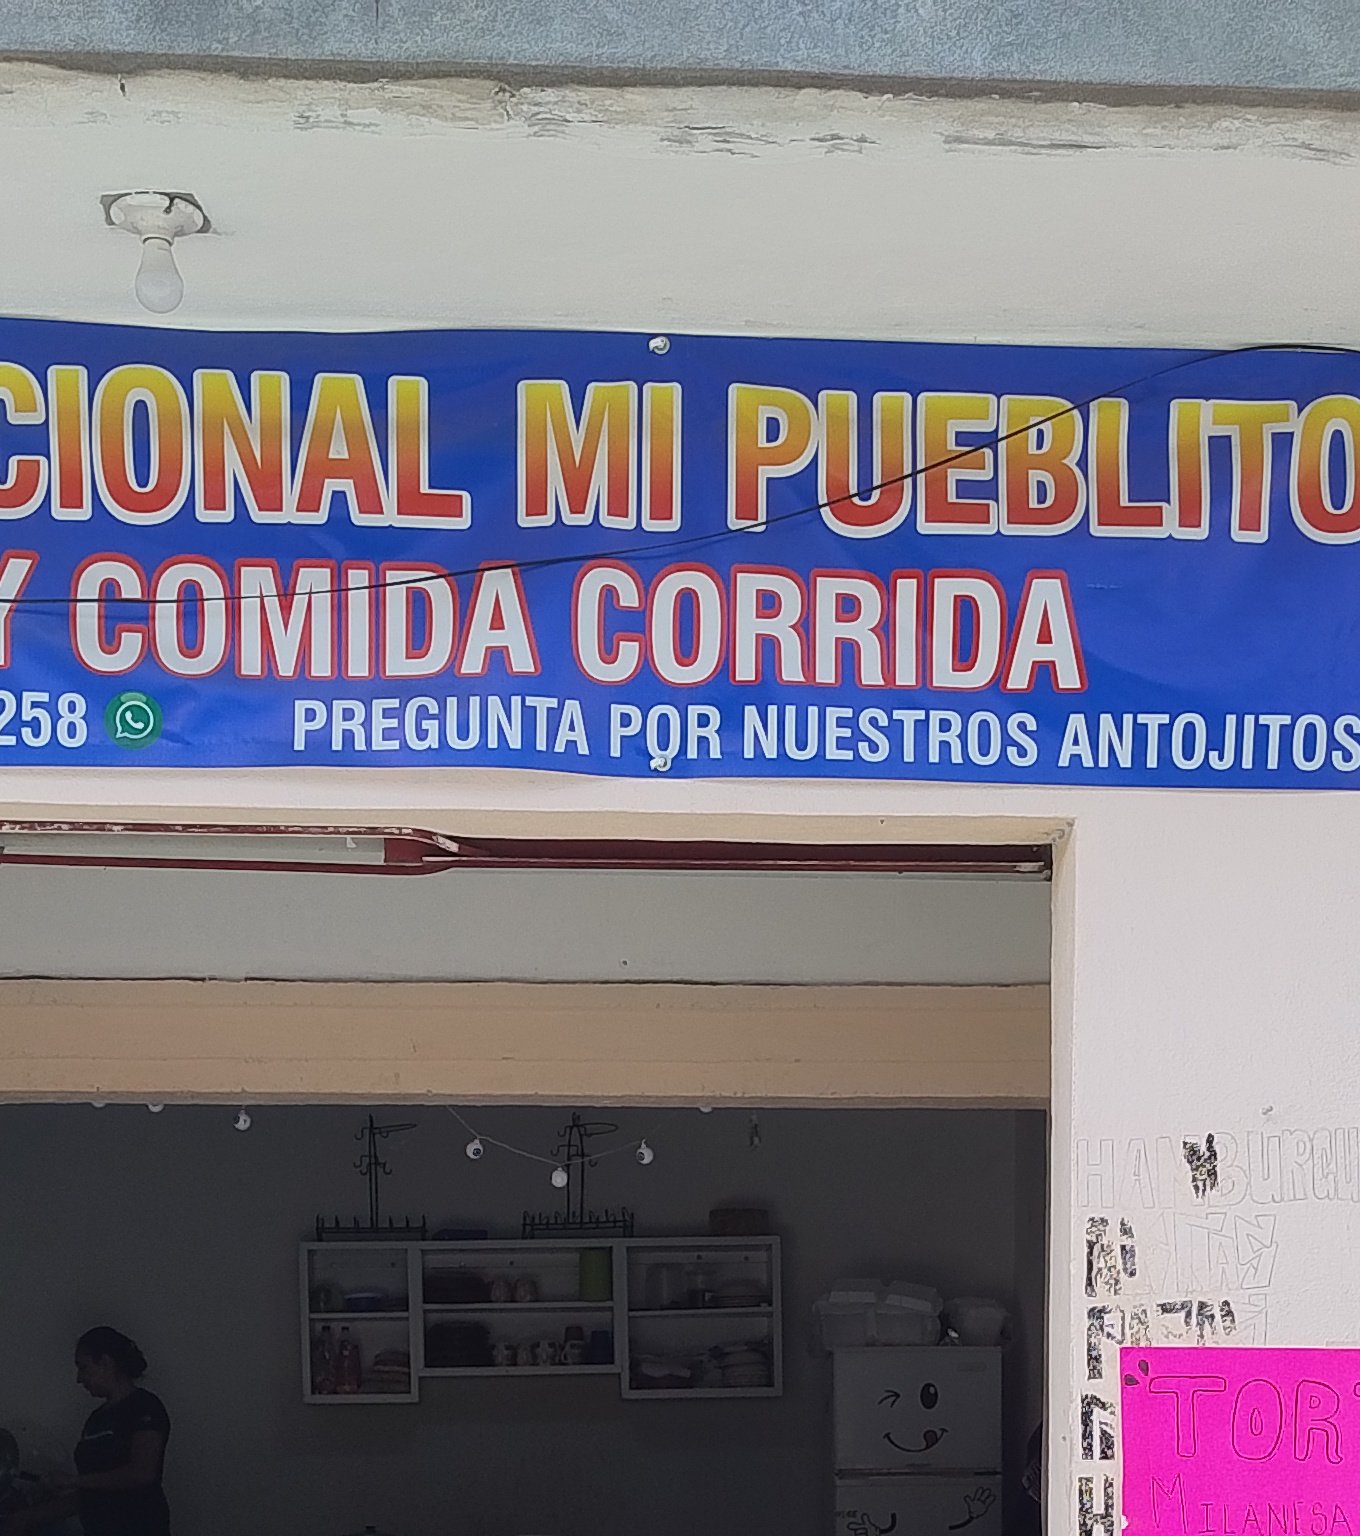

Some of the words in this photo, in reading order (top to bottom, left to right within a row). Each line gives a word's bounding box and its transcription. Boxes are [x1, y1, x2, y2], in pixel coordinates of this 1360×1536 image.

[517, 379, 682, 531] MI
[71, 552, 541, 681] COMIDA
[572, 560, 1087, 692] CORRIDA
[292, 695, 589, 756] PREGUNTA
[609, 703, 722, 762] POR
[742, 704, 1038, 767] NUESTROS
